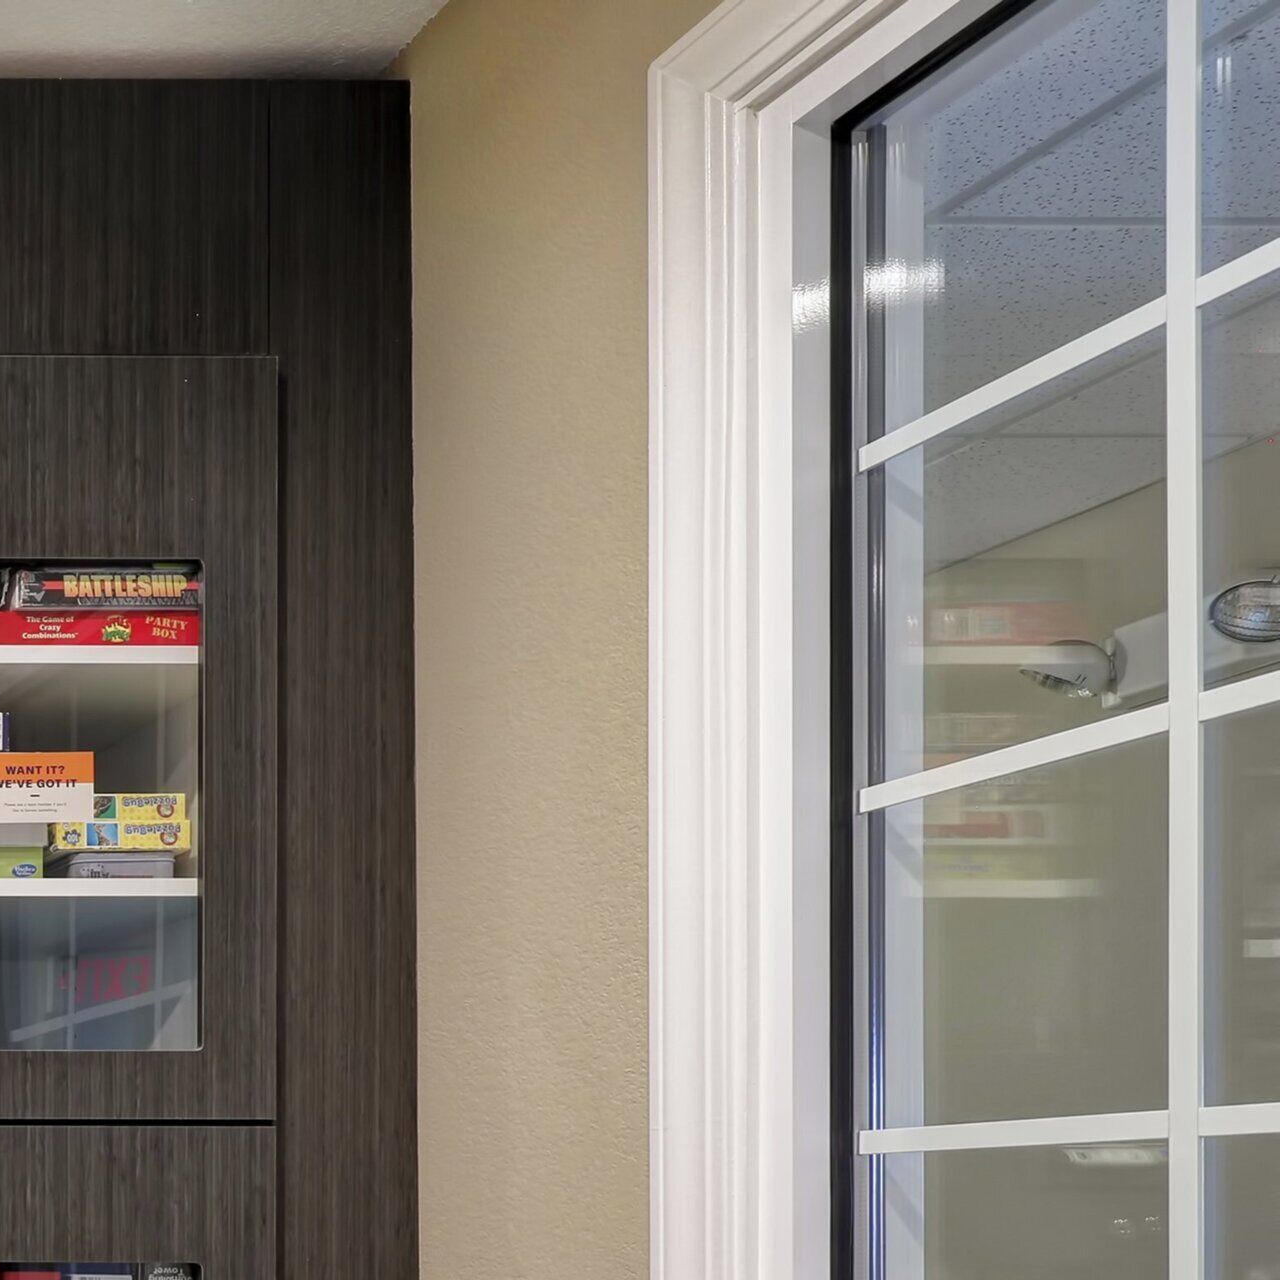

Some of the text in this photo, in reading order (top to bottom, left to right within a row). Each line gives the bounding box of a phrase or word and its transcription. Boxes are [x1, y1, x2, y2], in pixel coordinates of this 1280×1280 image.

[63, 574, 188, 598] BATTLESHIP
[39, 624, 61, 632] Crazy
[145, 616, 188, 630] PARTY
[152, 627, 178, 640] BOX
[5, 766, 65, 775] WANT IT?
[37, 779, 62, 788] GOT
[66, 779, 77, 787] IT
